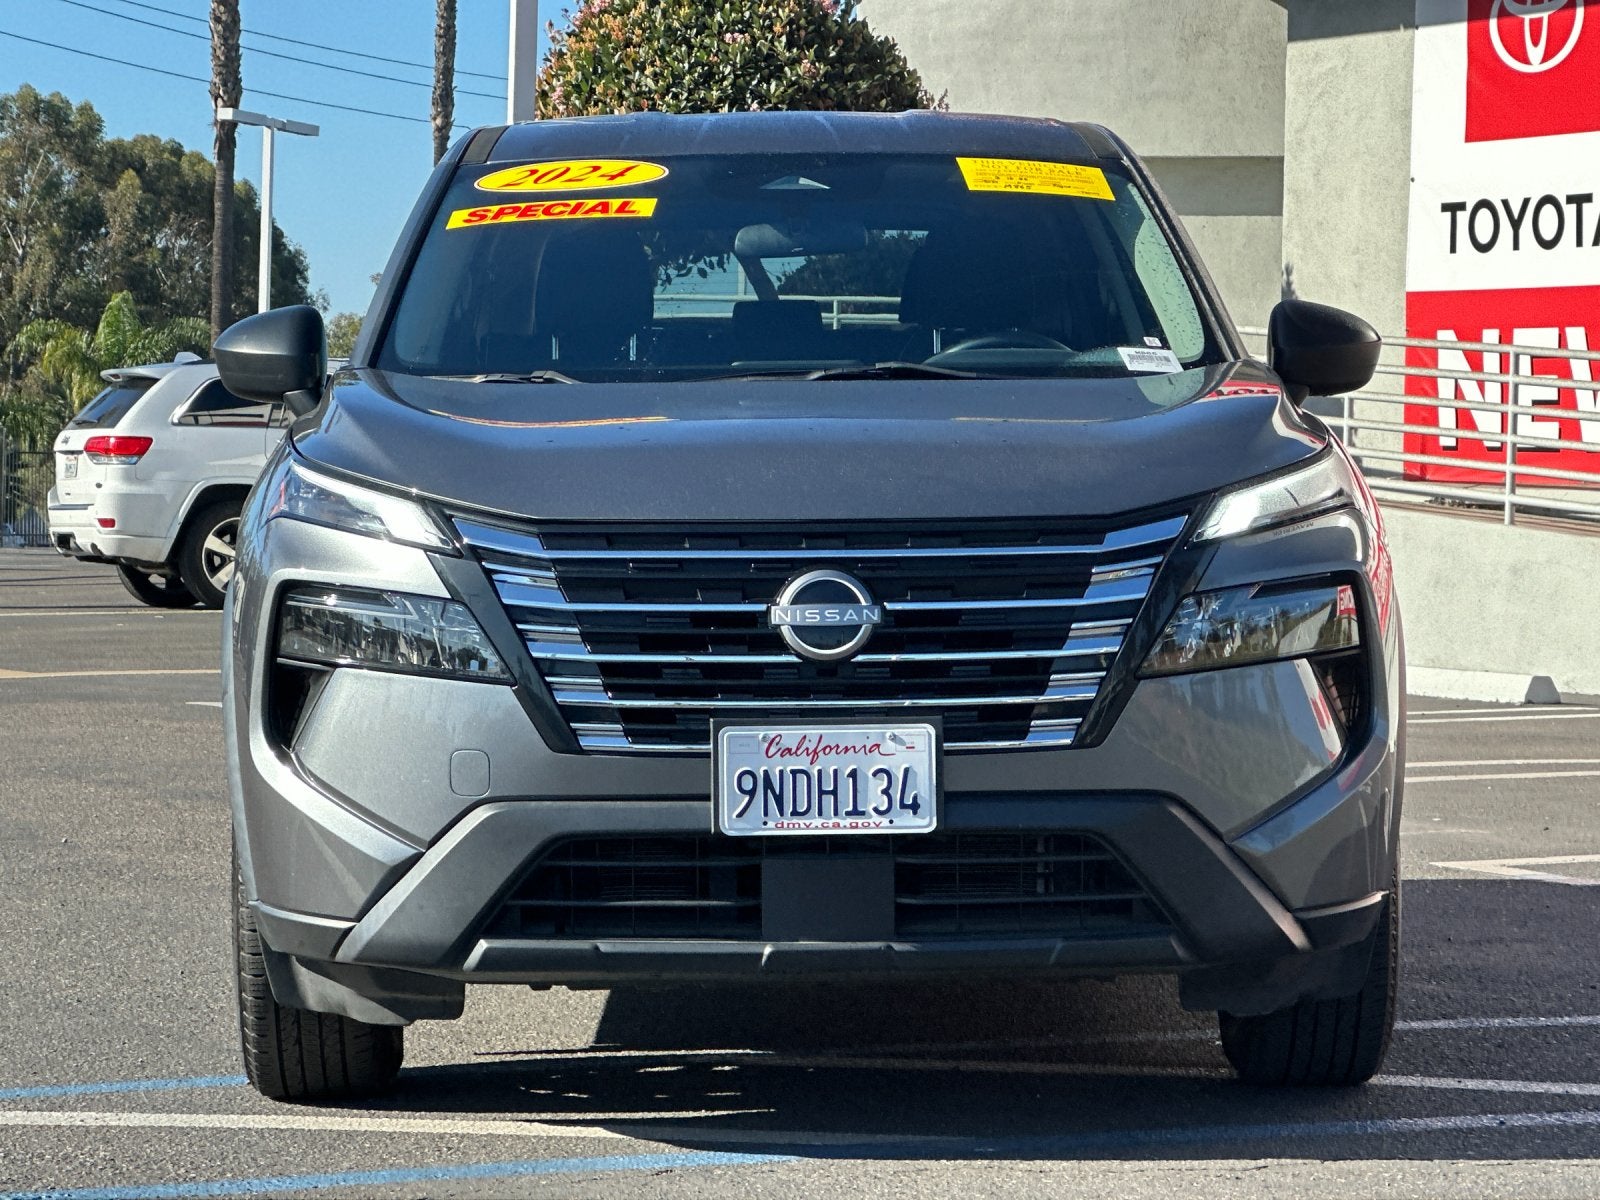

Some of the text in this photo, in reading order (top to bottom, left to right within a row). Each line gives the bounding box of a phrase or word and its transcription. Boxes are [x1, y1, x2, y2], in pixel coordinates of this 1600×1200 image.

[498, 164, 641, 188] 2024
[463, 200, 640, 224] SPECIAL
[775, 608, 879, 622] NISSAN
[765, 734, 896, 765] California
[734, 766, 921, 818] 9NDH134
[774, 820, 883, 830] dmv.ca.gov
